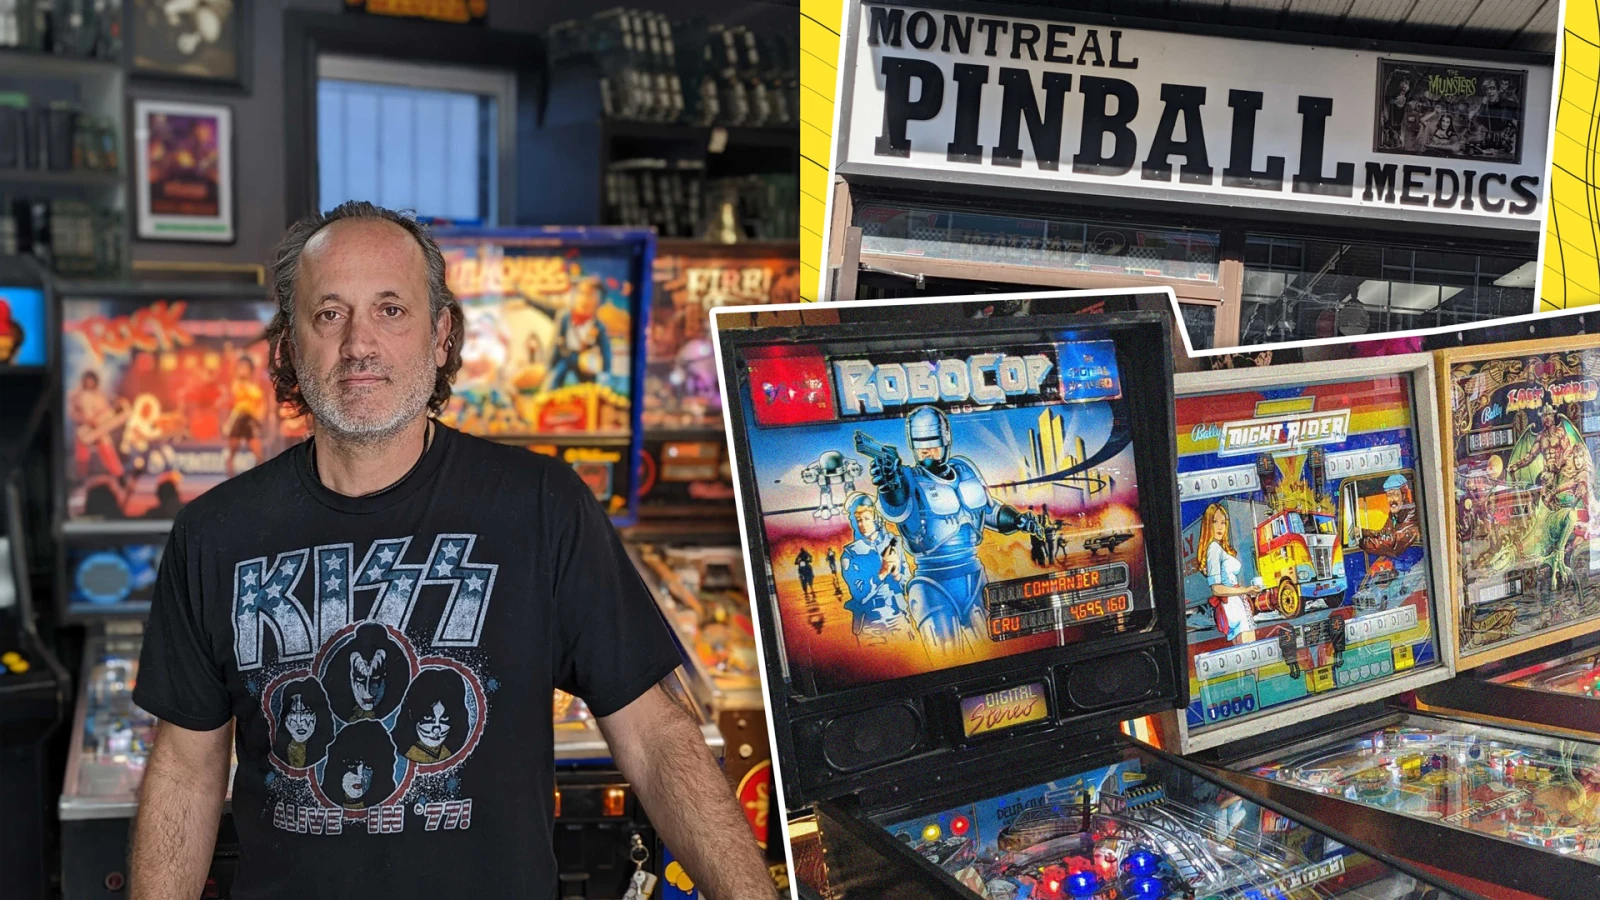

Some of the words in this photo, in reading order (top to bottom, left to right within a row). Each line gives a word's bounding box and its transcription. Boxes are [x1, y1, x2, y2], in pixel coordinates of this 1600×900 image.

[867, 6, 1139, 70] MONTREAL
[1428, 74, 1477, 99] MUNSTERS
[1447, 69, 1459, 77] THE
[874, 56, 1356, 200] PINBALL
[1362, 161, 1540, 216] MEDICS
[1481, 402, 1503, 424] Bally
[1506, 386, 1544, 415] LOST
[1548, 379, 1599, 407] WORLD
[1191, 422, 1222, 443] Bally
[1229, 425, 1283, 450] NIGHT
[1287, 415, 1347, 448] RIDER
[231, 533, 499, 671] KISS
[1023, 571, 1099, 599] COMMANDER
[992, 616, 1021, 636] CRU
[985, 685, 1037, 708] DIGITAL
[970, 699, 1037, 734] Stereo
[273, 802, 344, 836] ALIVE
[367, 804, 405, 835] IN
[996, 803, 1023, 820] DELTA
[1025, 795, 1046, 809] CITY
